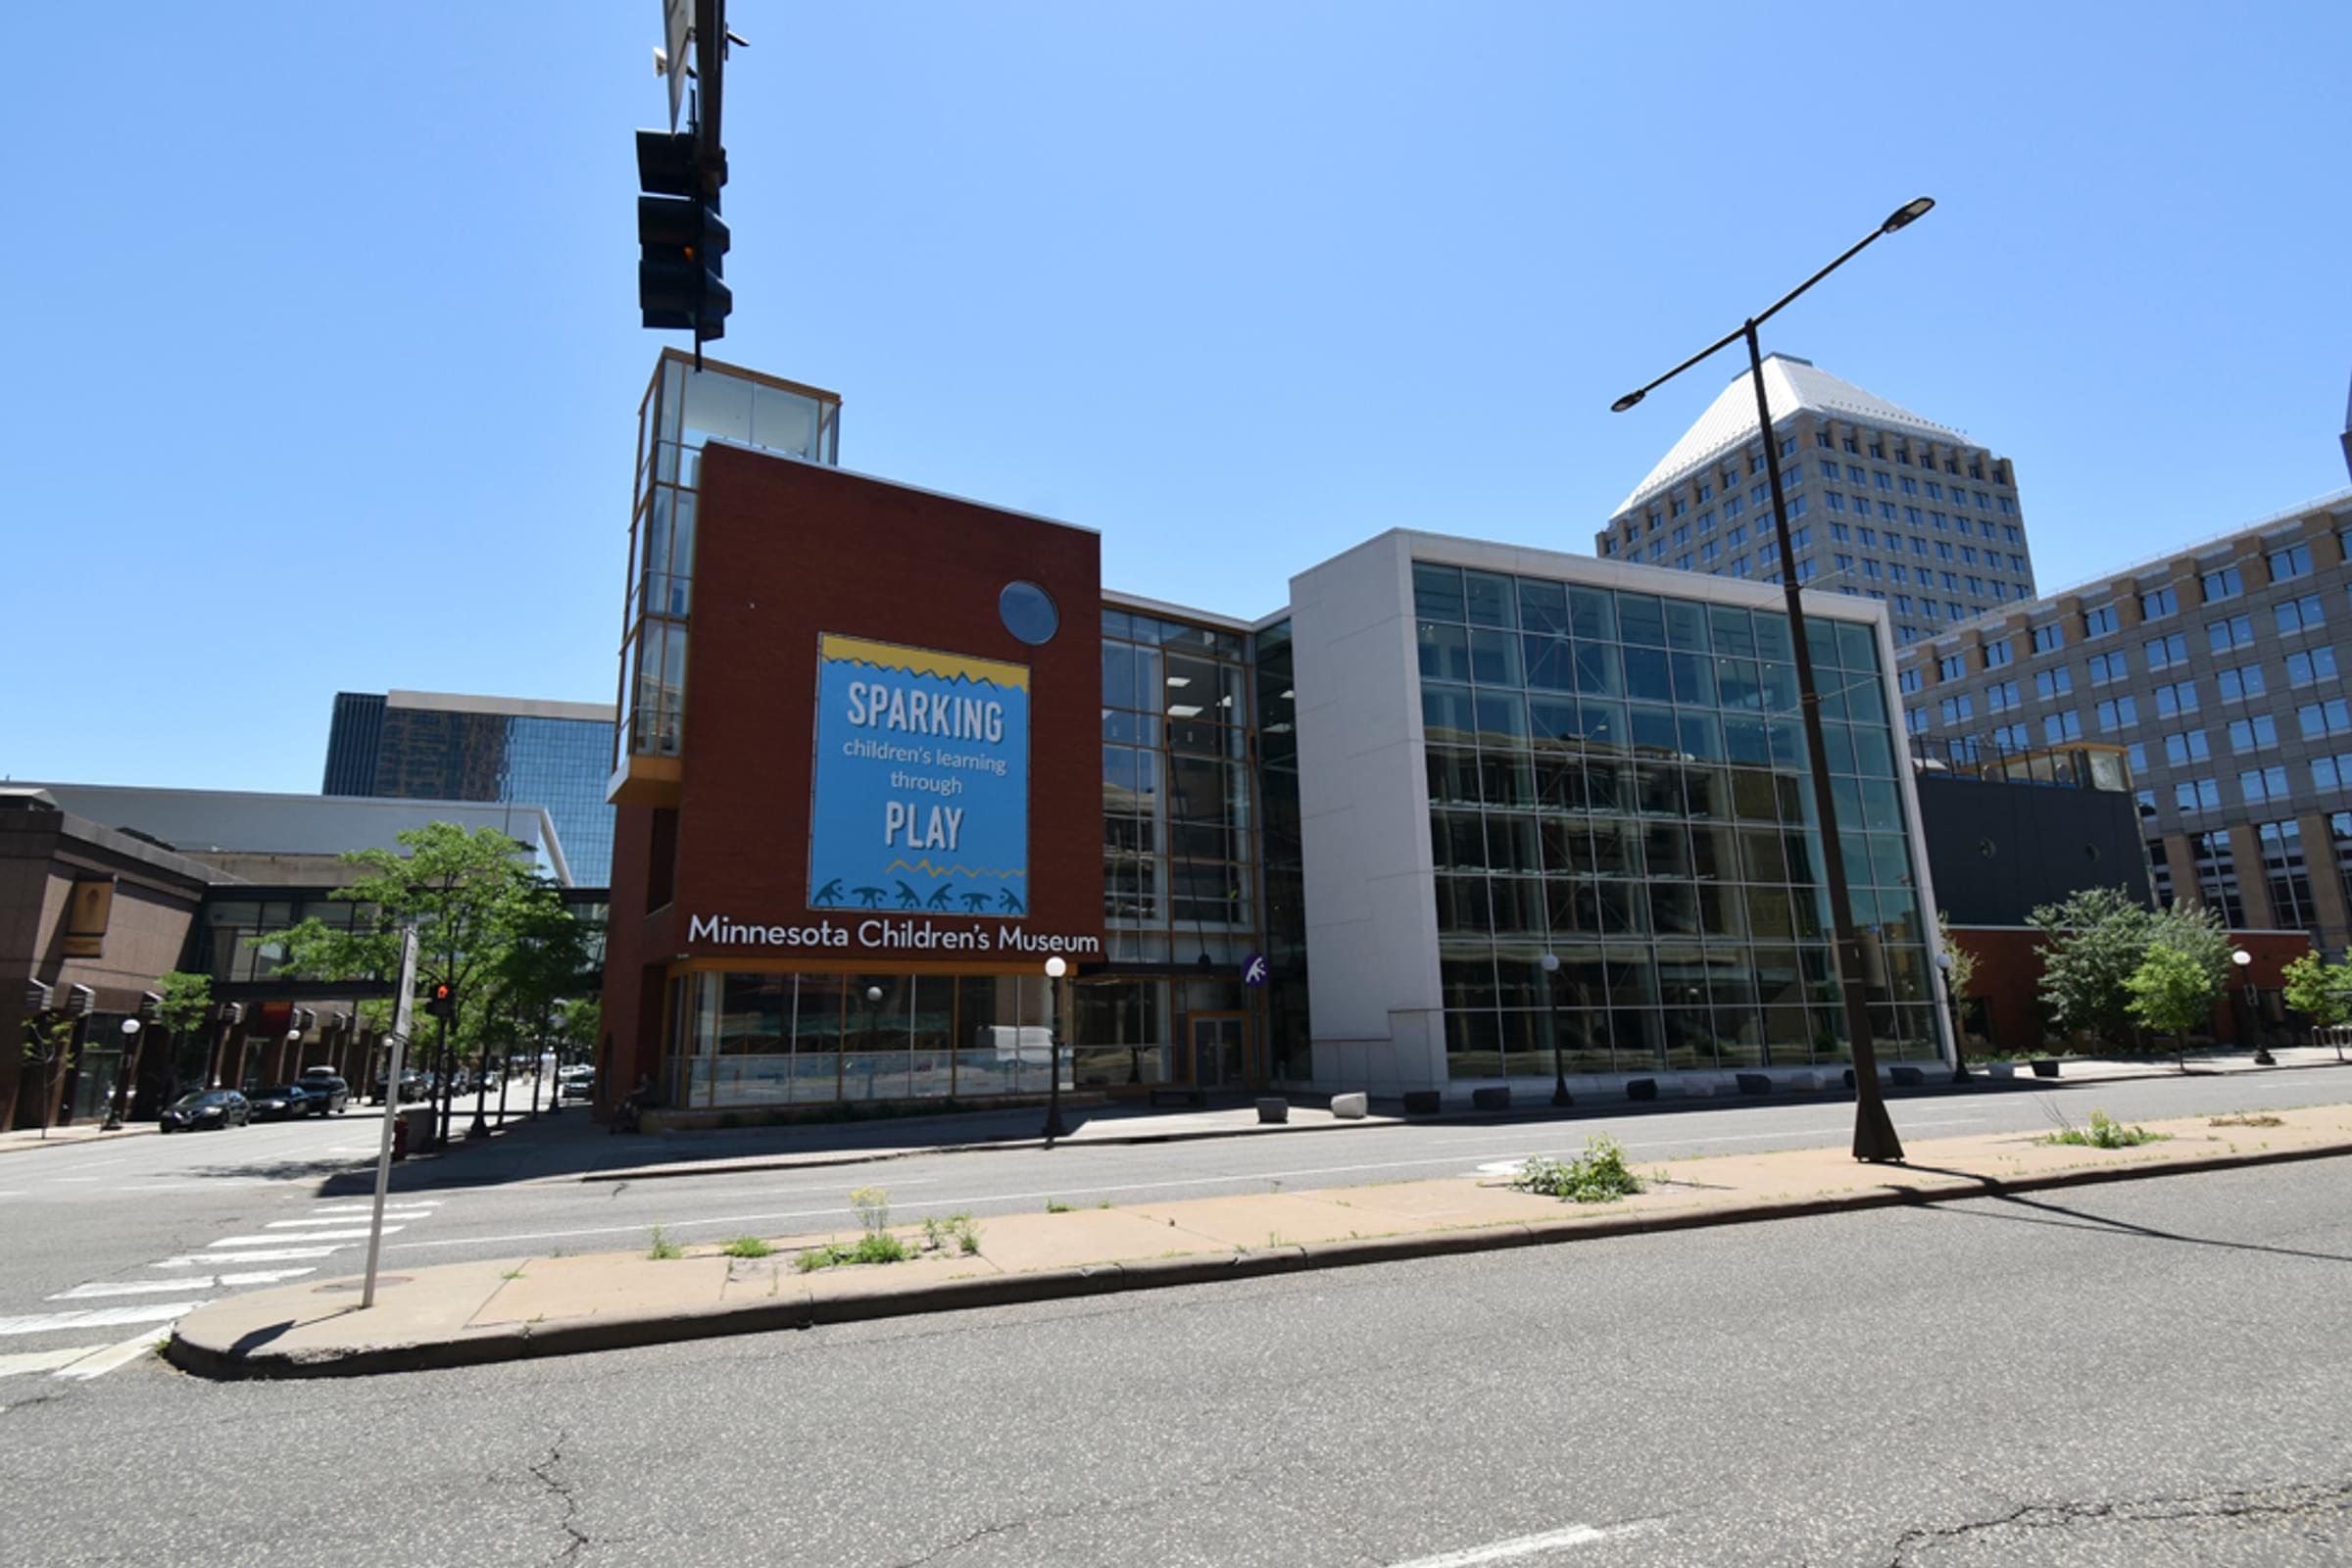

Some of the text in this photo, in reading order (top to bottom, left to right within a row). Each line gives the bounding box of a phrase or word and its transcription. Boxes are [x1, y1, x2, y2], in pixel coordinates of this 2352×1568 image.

[847, 681, 1004, 743] SPARKING
[843, 739, 1006, 775] children's learning
[891, 771, 962, 796] through
[885, 801, 963, 851] PLAY
[688, 914, 1100, 953] Minnesota Children's Museum
